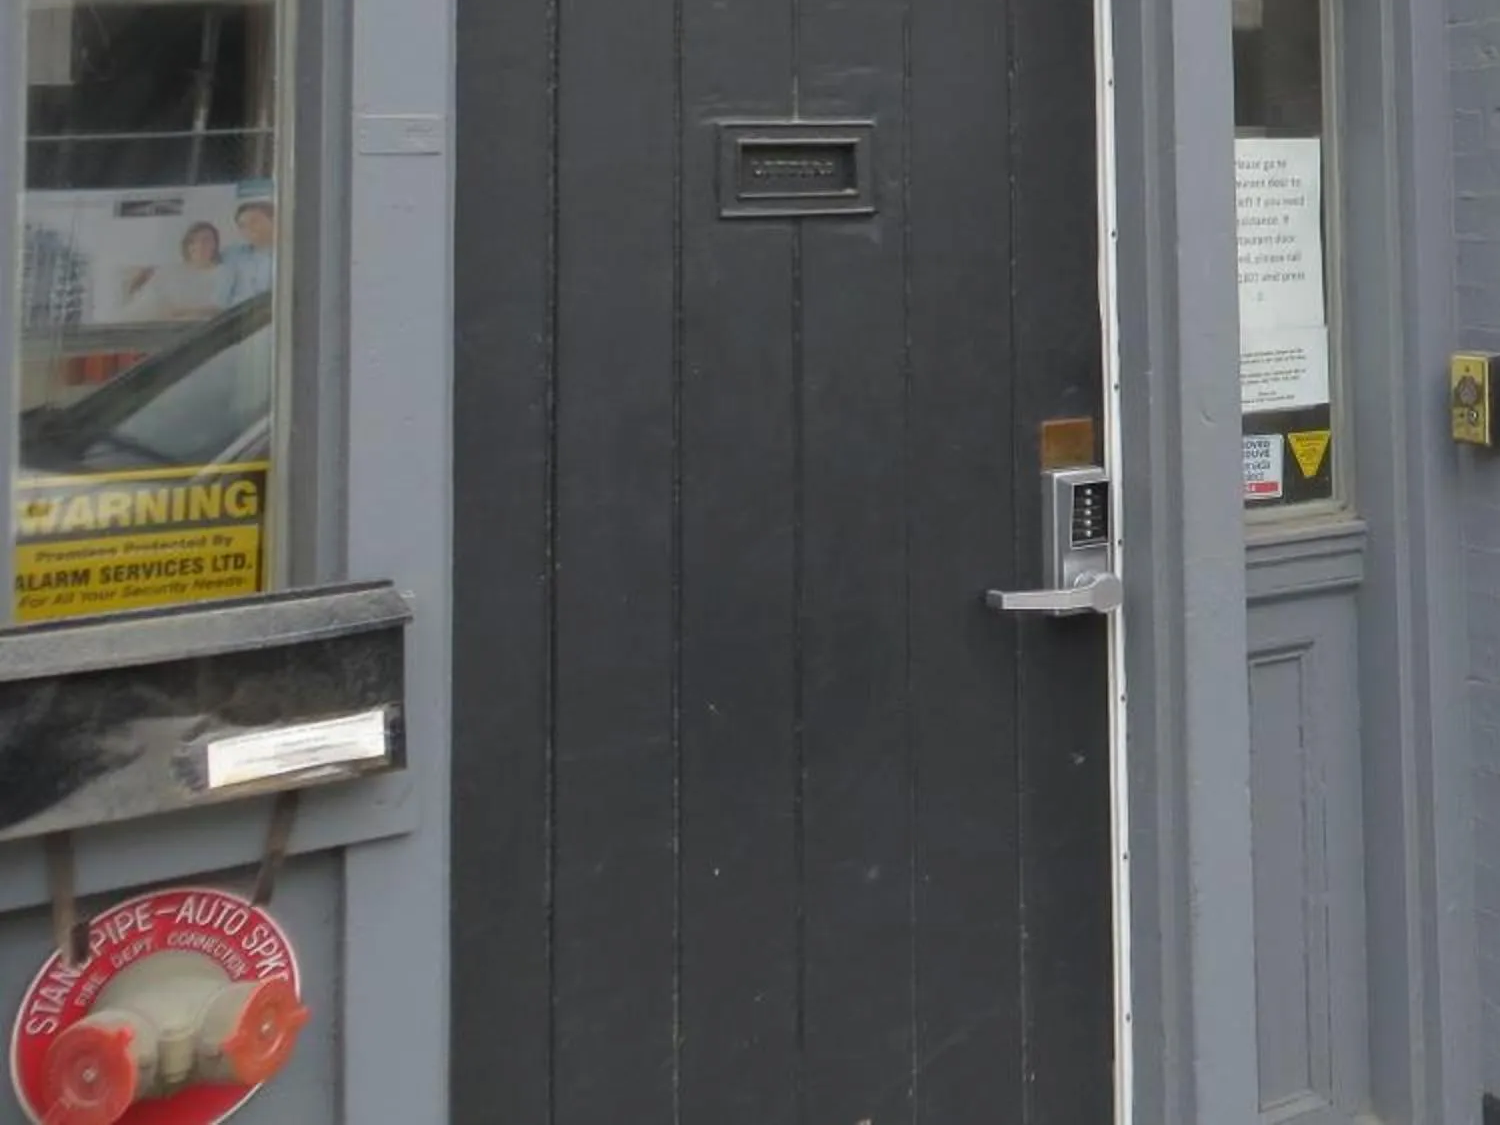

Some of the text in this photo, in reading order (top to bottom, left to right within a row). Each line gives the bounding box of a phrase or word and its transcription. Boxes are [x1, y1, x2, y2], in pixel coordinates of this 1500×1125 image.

[17, 480, 258, 537] WARNING
[16, 551, 253, 594] ALARM SERVICES LTD.
